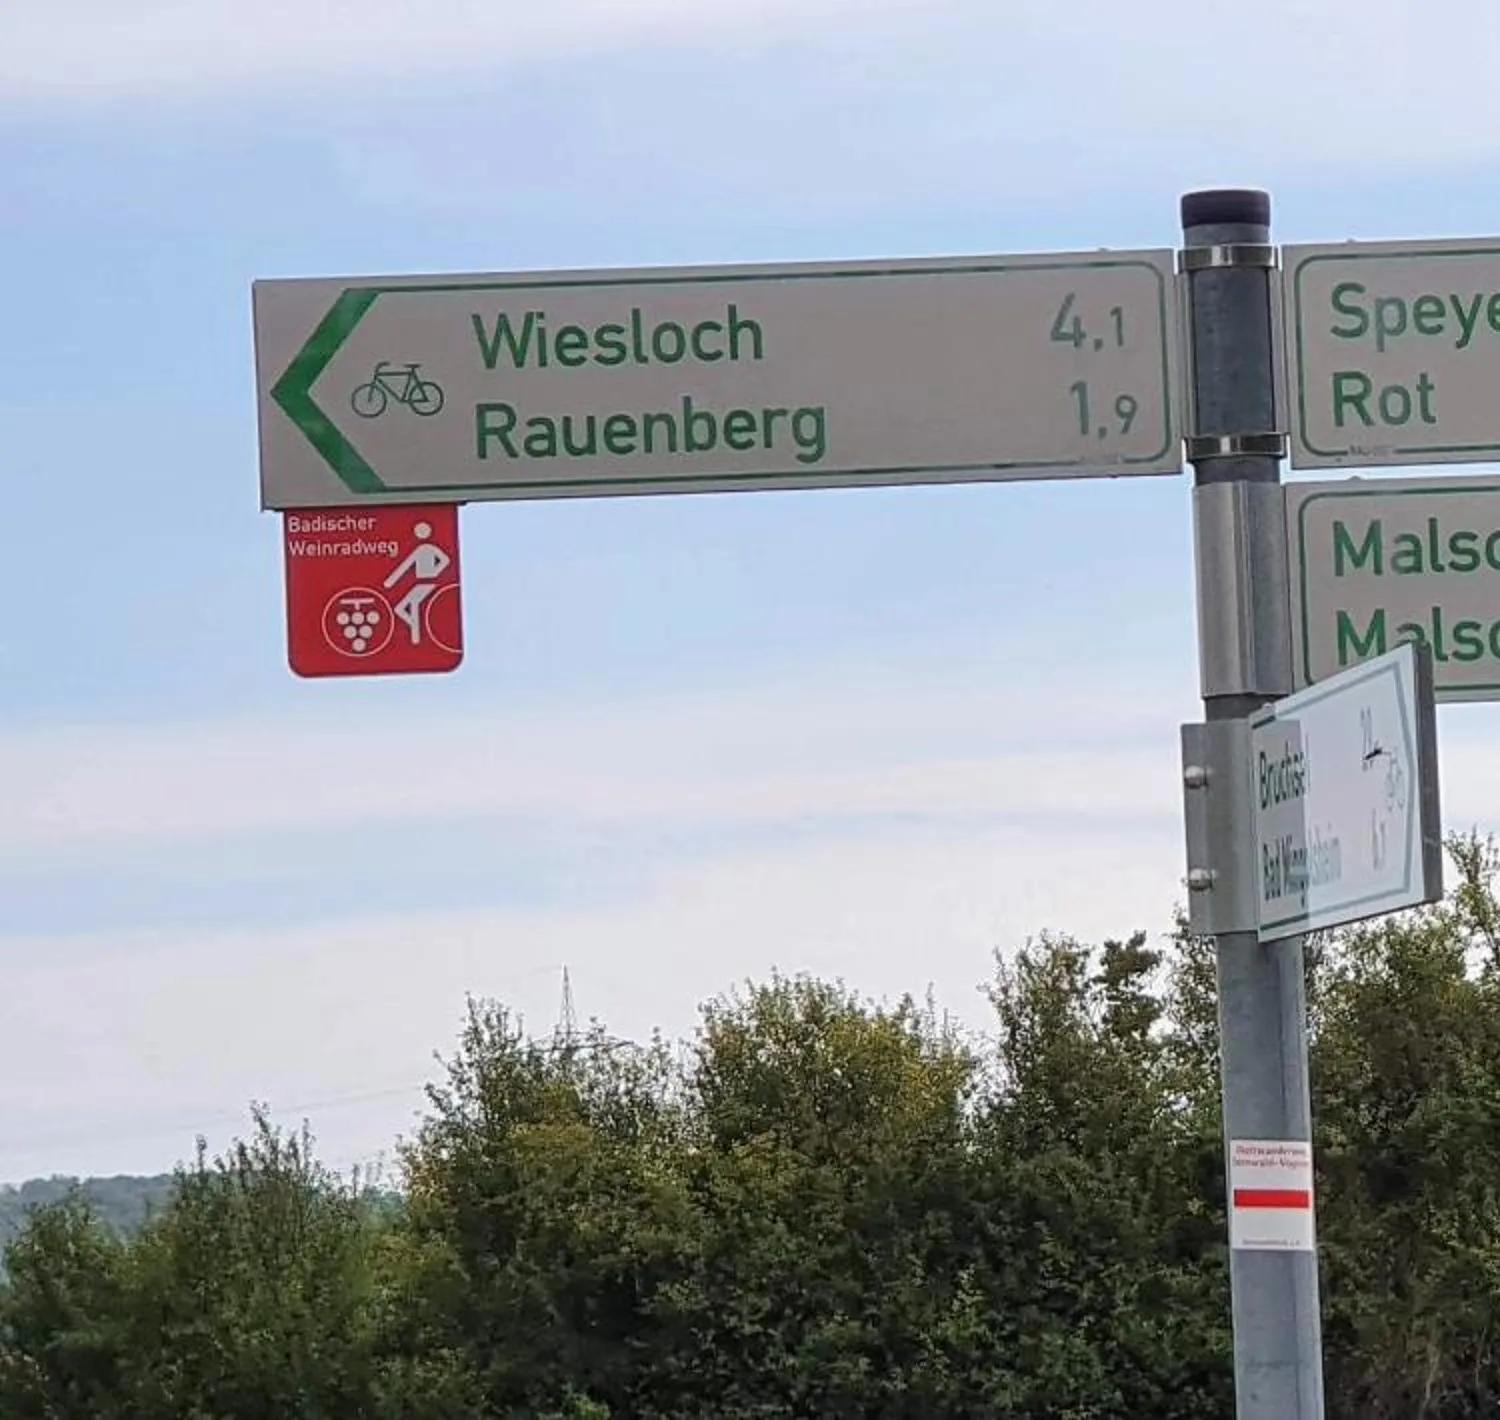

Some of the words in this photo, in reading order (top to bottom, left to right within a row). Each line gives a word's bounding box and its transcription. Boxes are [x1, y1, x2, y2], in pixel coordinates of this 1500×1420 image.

[471, 303, 764, 370] Wiesloch
[1050, 292, 1124, 352] 4,1
[474, 395, 826, 464] Rauenberg
[1070, 380, 1137, 439] 1,9
[1332, 370, 1437, 428] Rot
[287, 514, 377, 533] Badischer
[288, 538, 399, 557] Weinradweg
